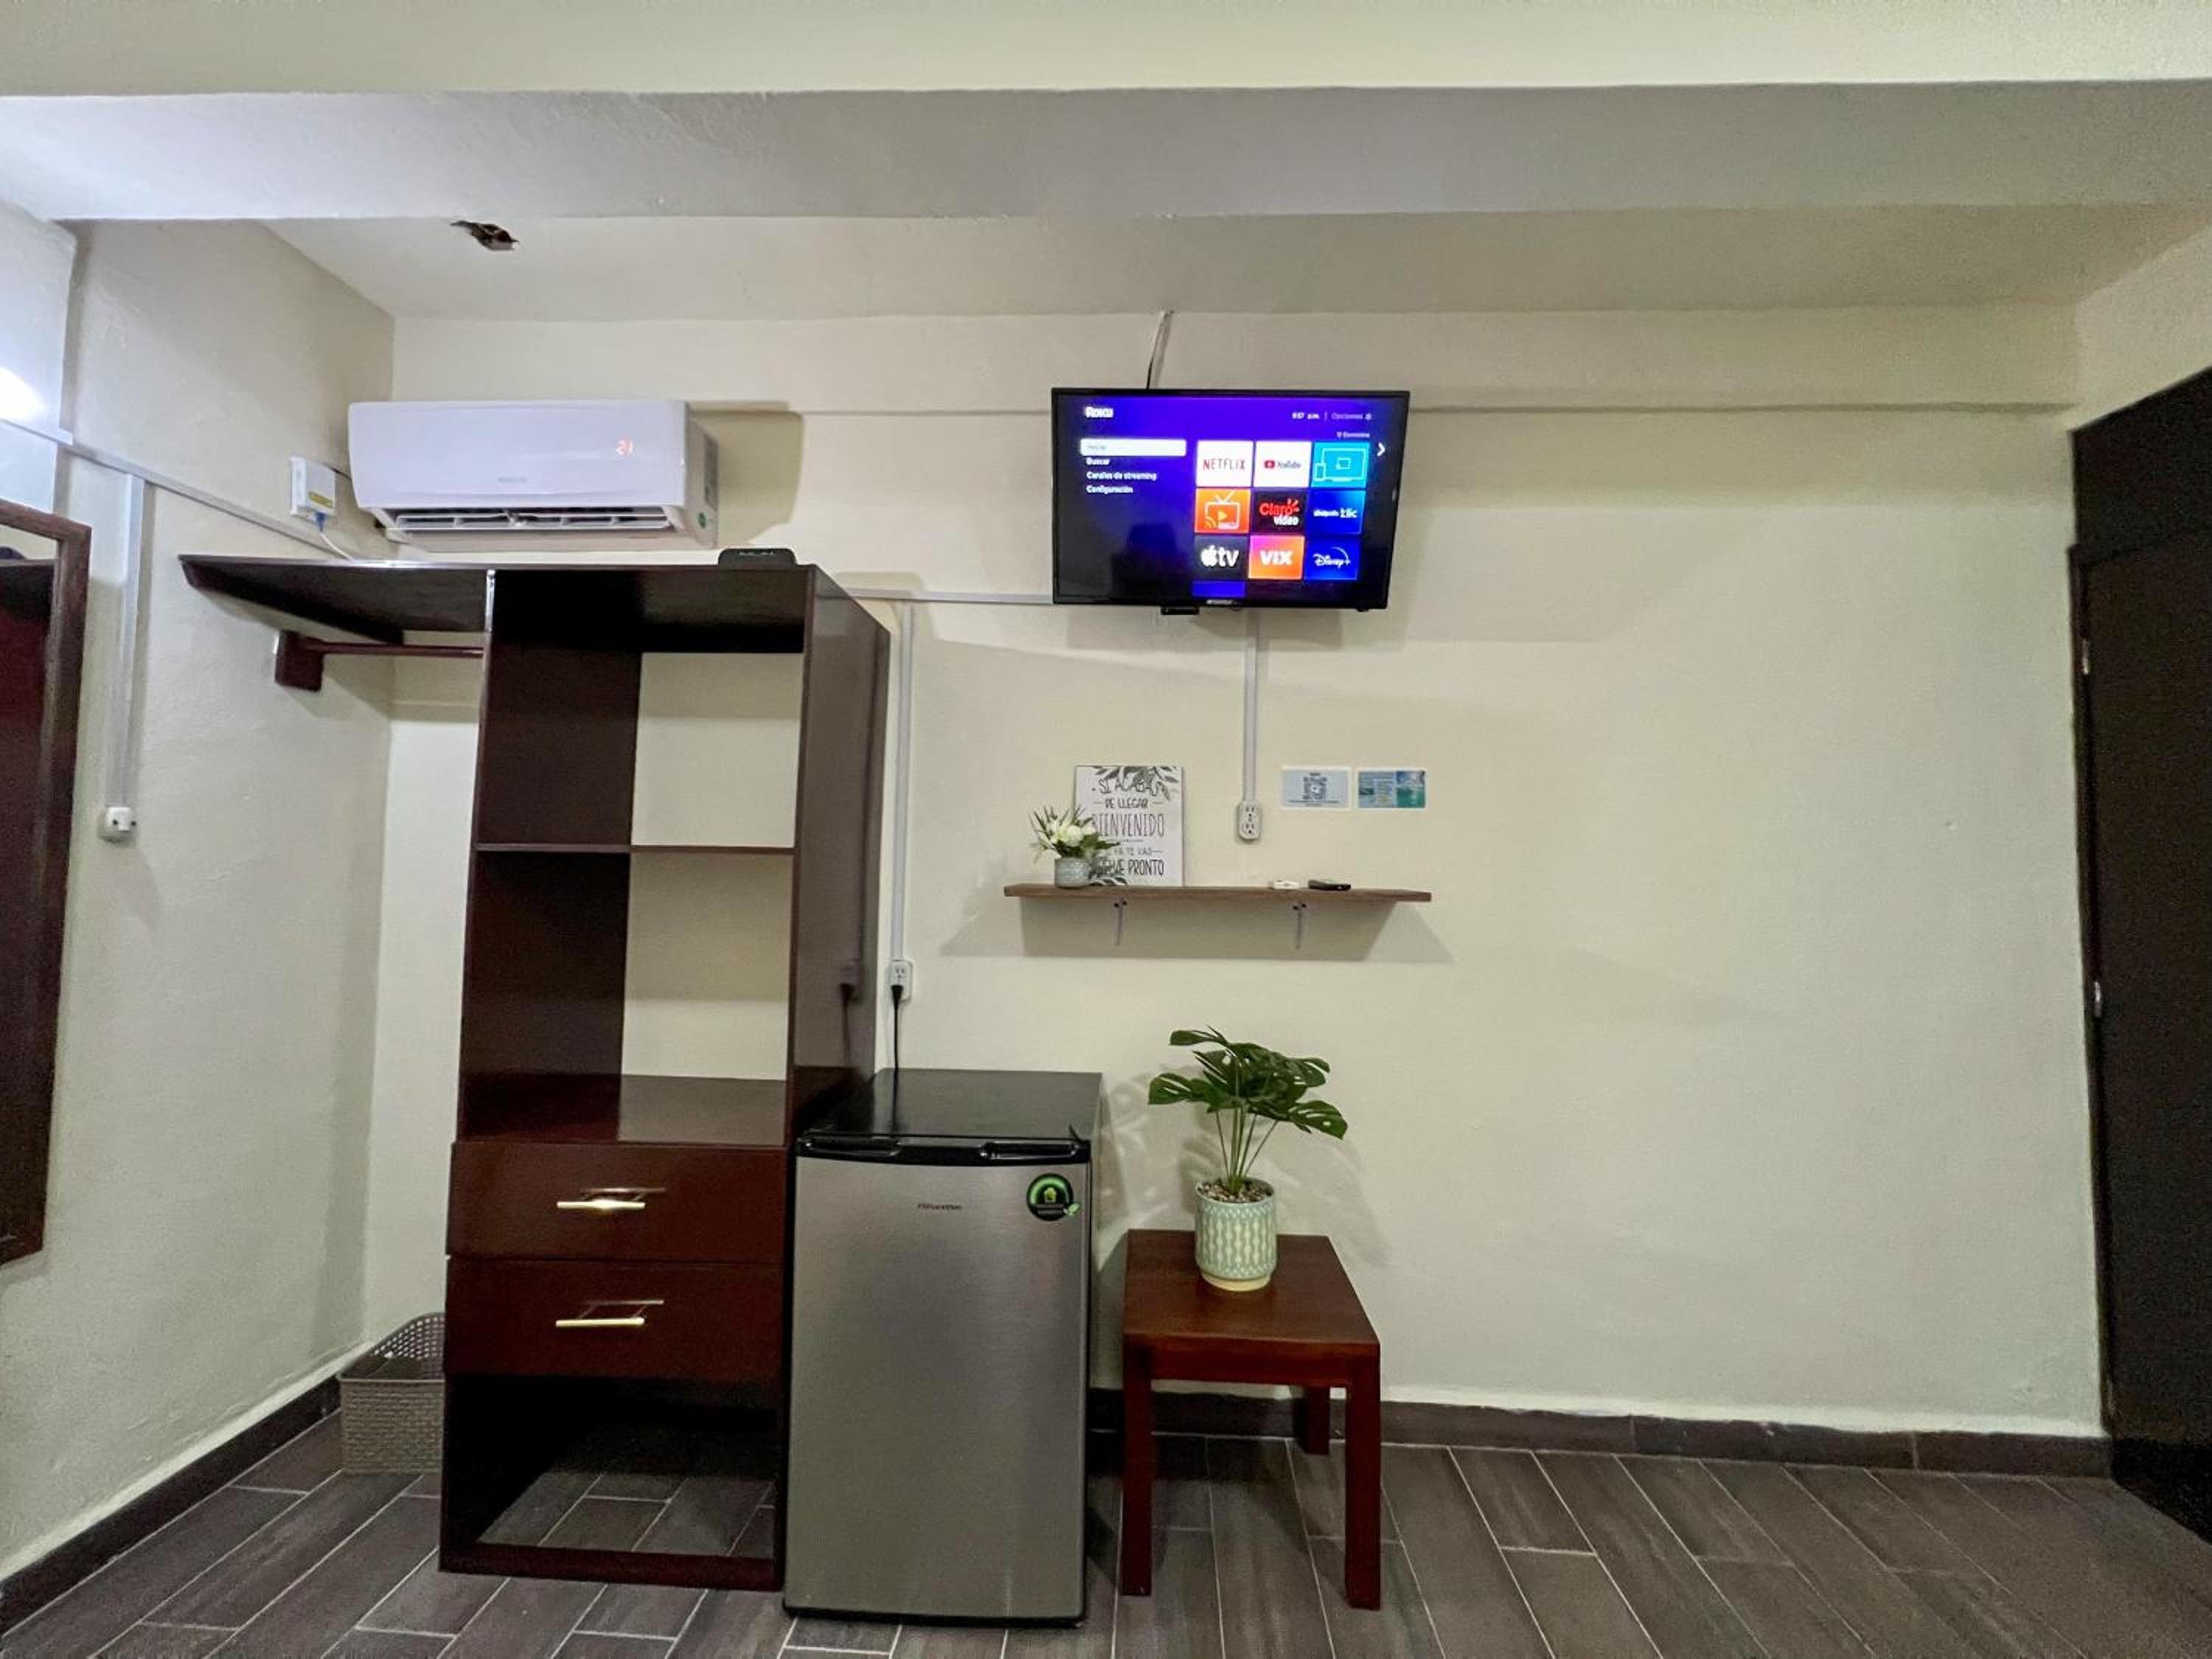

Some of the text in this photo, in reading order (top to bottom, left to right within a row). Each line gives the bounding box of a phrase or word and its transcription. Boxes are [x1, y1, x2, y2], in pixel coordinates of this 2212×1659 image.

[1203, 459, 1245, 470] NETFLIX
[1259, 501, 1293, 516] Claro
[1217, 547, 1239, 567] tv
[1128, 859, 1164, 876] PRONTO
